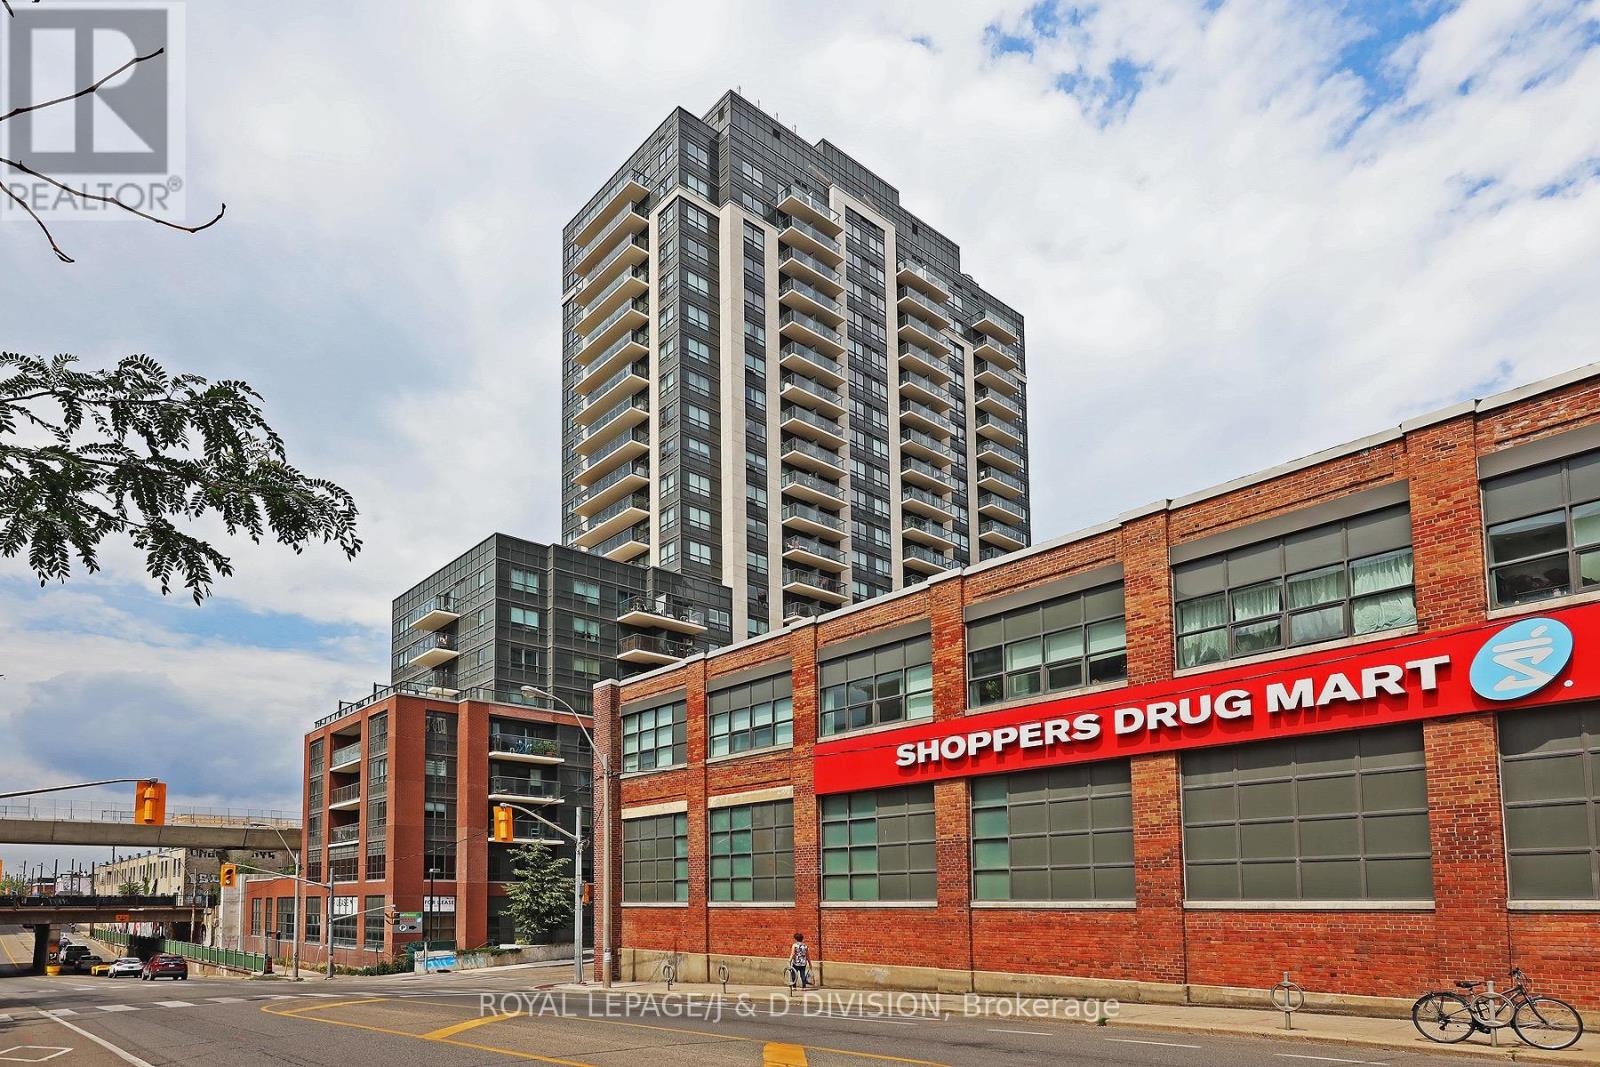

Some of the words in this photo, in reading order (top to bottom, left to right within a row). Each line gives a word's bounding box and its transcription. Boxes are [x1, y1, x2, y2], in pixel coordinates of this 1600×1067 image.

[895, 713, 1101, 767] SHOPPERS
[1114, 689, 1252, 735] DRUG
[1267, 655, 1451, 713] MART
